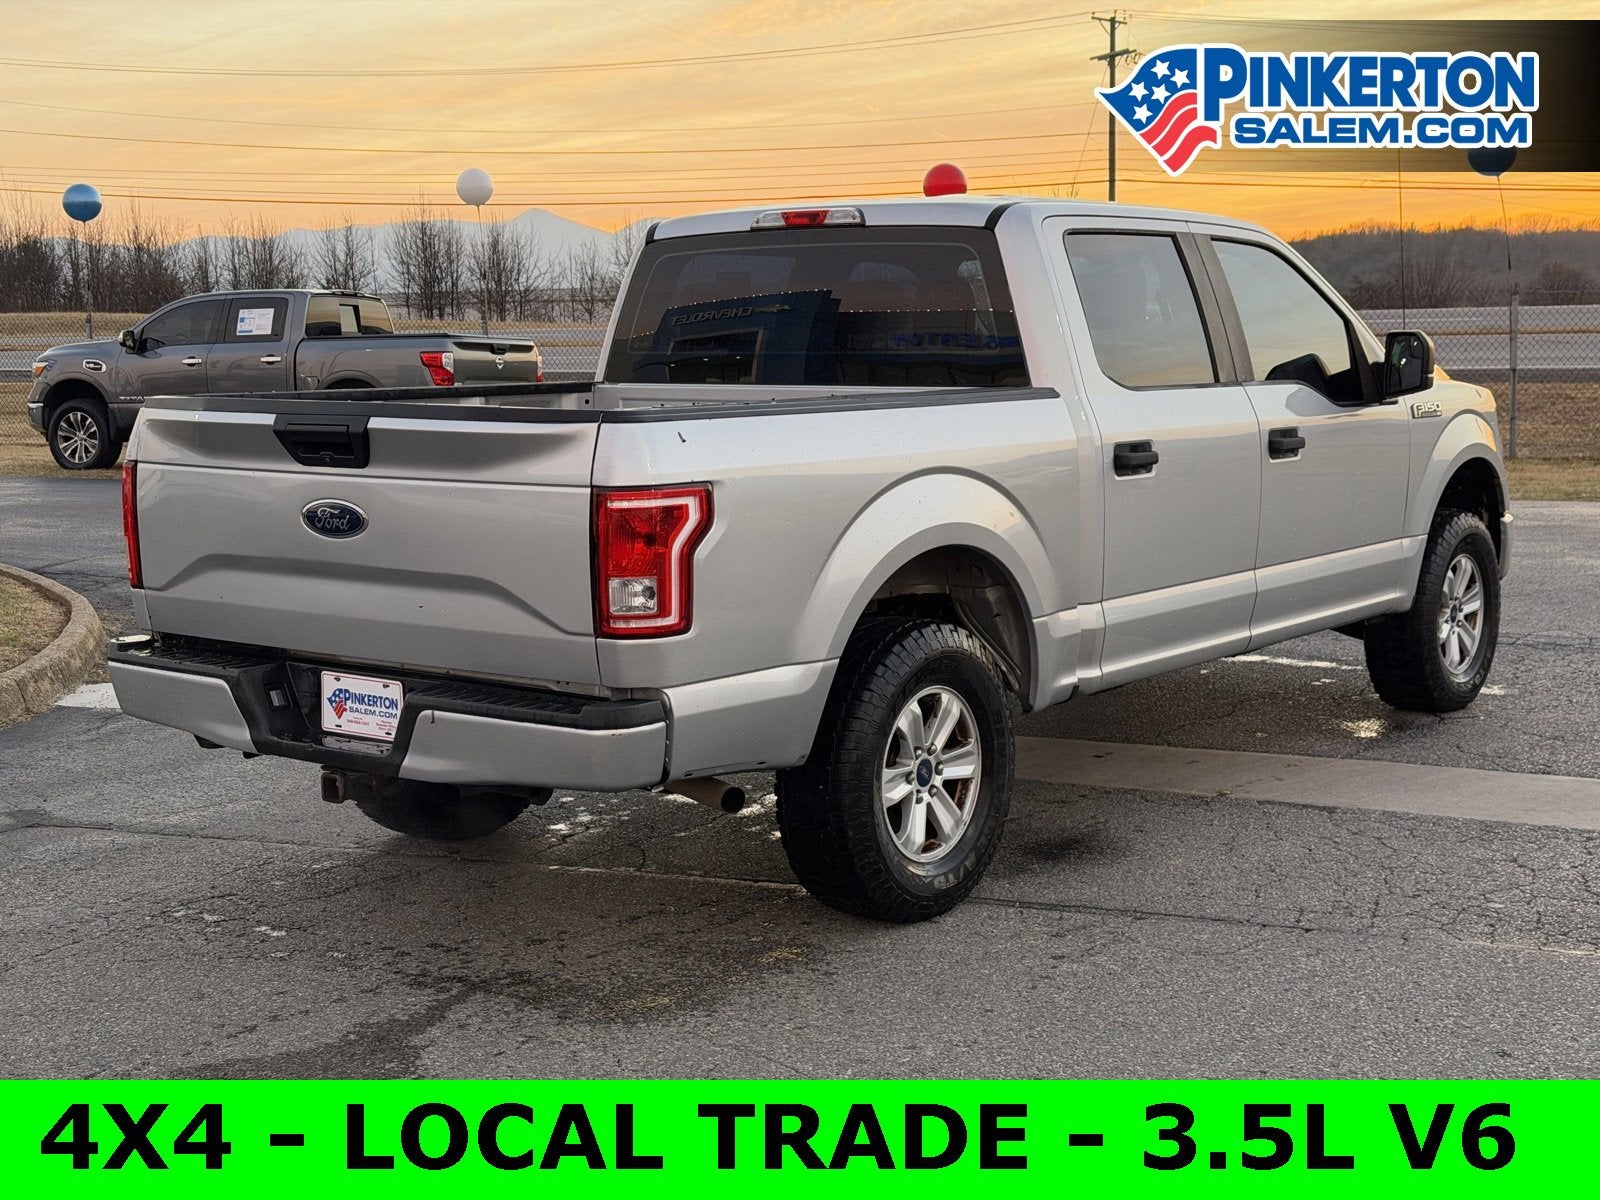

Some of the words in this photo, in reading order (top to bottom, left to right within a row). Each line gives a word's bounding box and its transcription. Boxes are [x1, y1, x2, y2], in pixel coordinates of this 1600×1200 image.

[315, 507, 350, 530] Ford
[343, 688, 399, 711] PINKERTON
[348, 705, 398, 720] SALEM.COM
